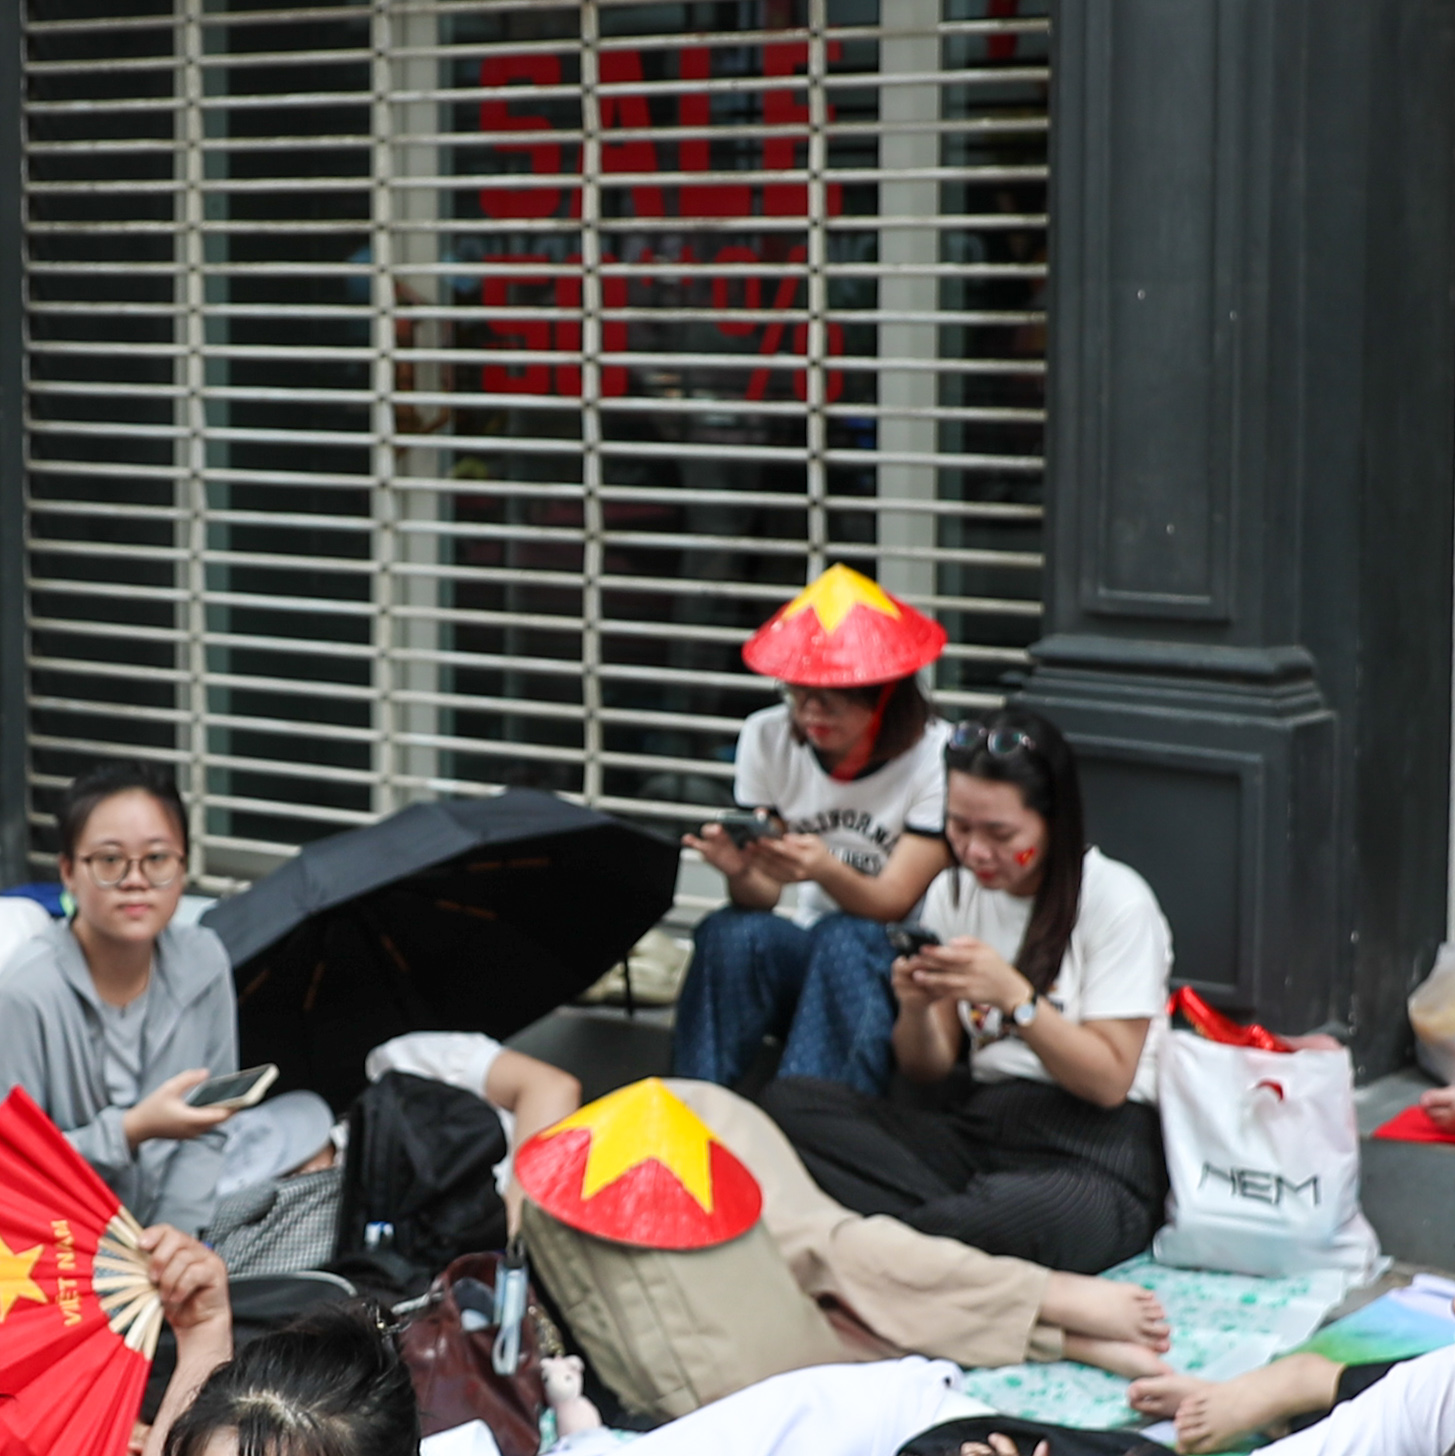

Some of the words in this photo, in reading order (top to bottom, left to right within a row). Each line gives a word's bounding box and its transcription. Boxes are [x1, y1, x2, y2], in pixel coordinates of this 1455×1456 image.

[479, 30, 842, 219] SALE
[1197, 1161, 1320, 1207] NEM
[50, 1219, 76, 1270] NAM
